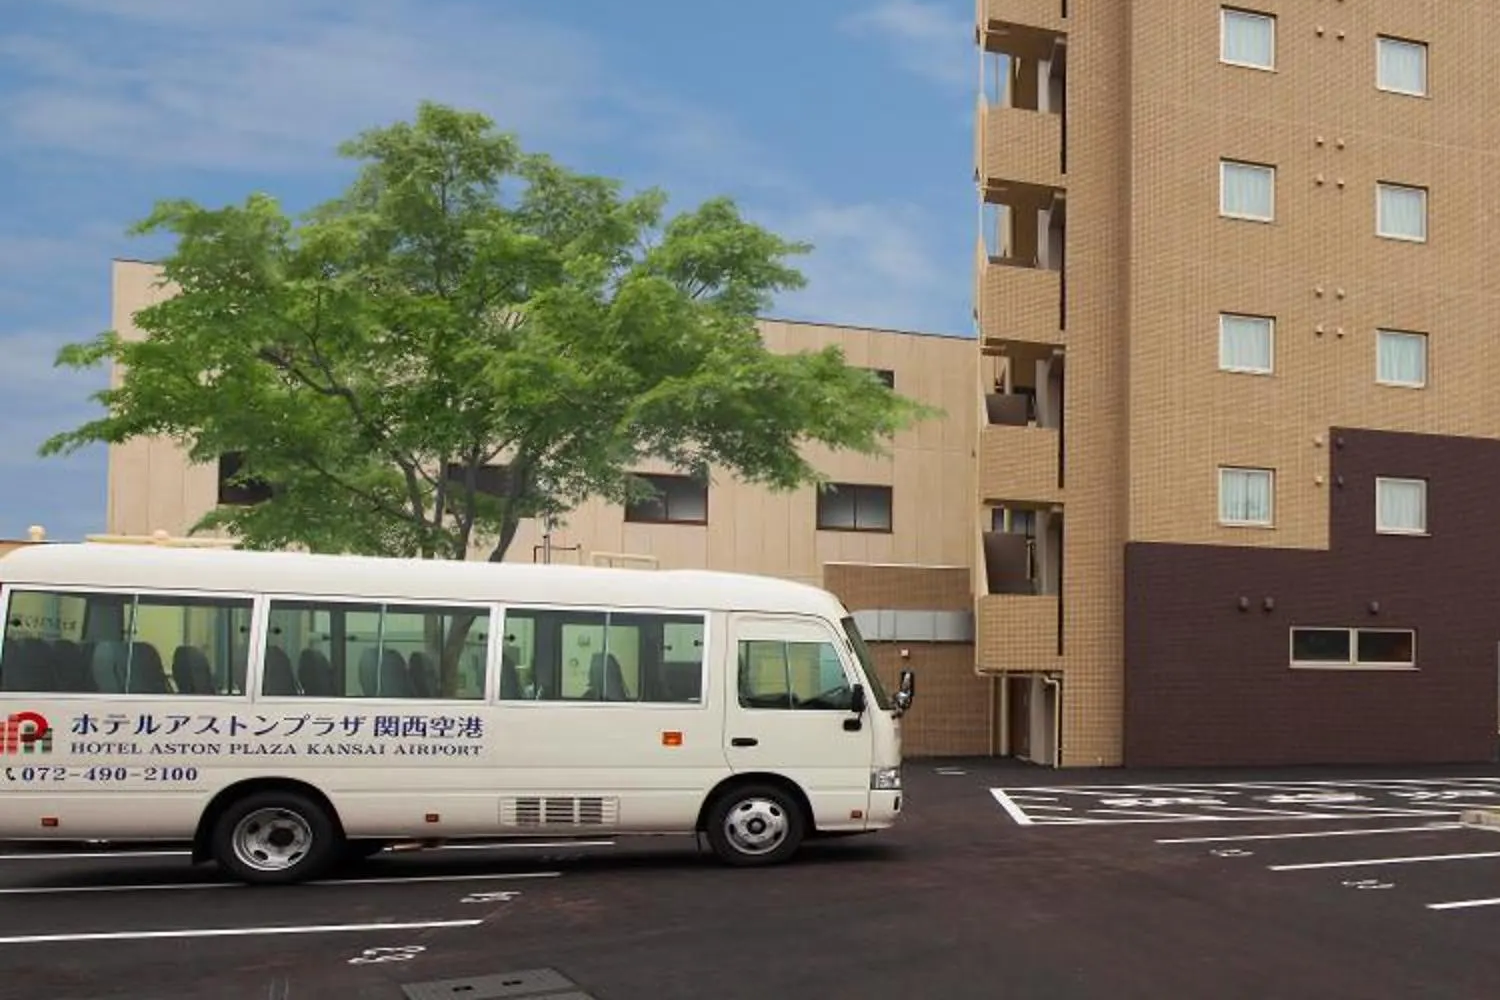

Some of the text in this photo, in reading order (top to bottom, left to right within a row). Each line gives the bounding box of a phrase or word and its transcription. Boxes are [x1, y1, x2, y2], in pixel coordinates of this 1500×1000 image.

[71, 714, 485, 738] ホテルアストンプラザ 関西空港
[71, 742, 484, 756] HOTEL ASTON PLAZA KANSAI AIRPORT
[22, 767, 199, 782] 072-490-2100
